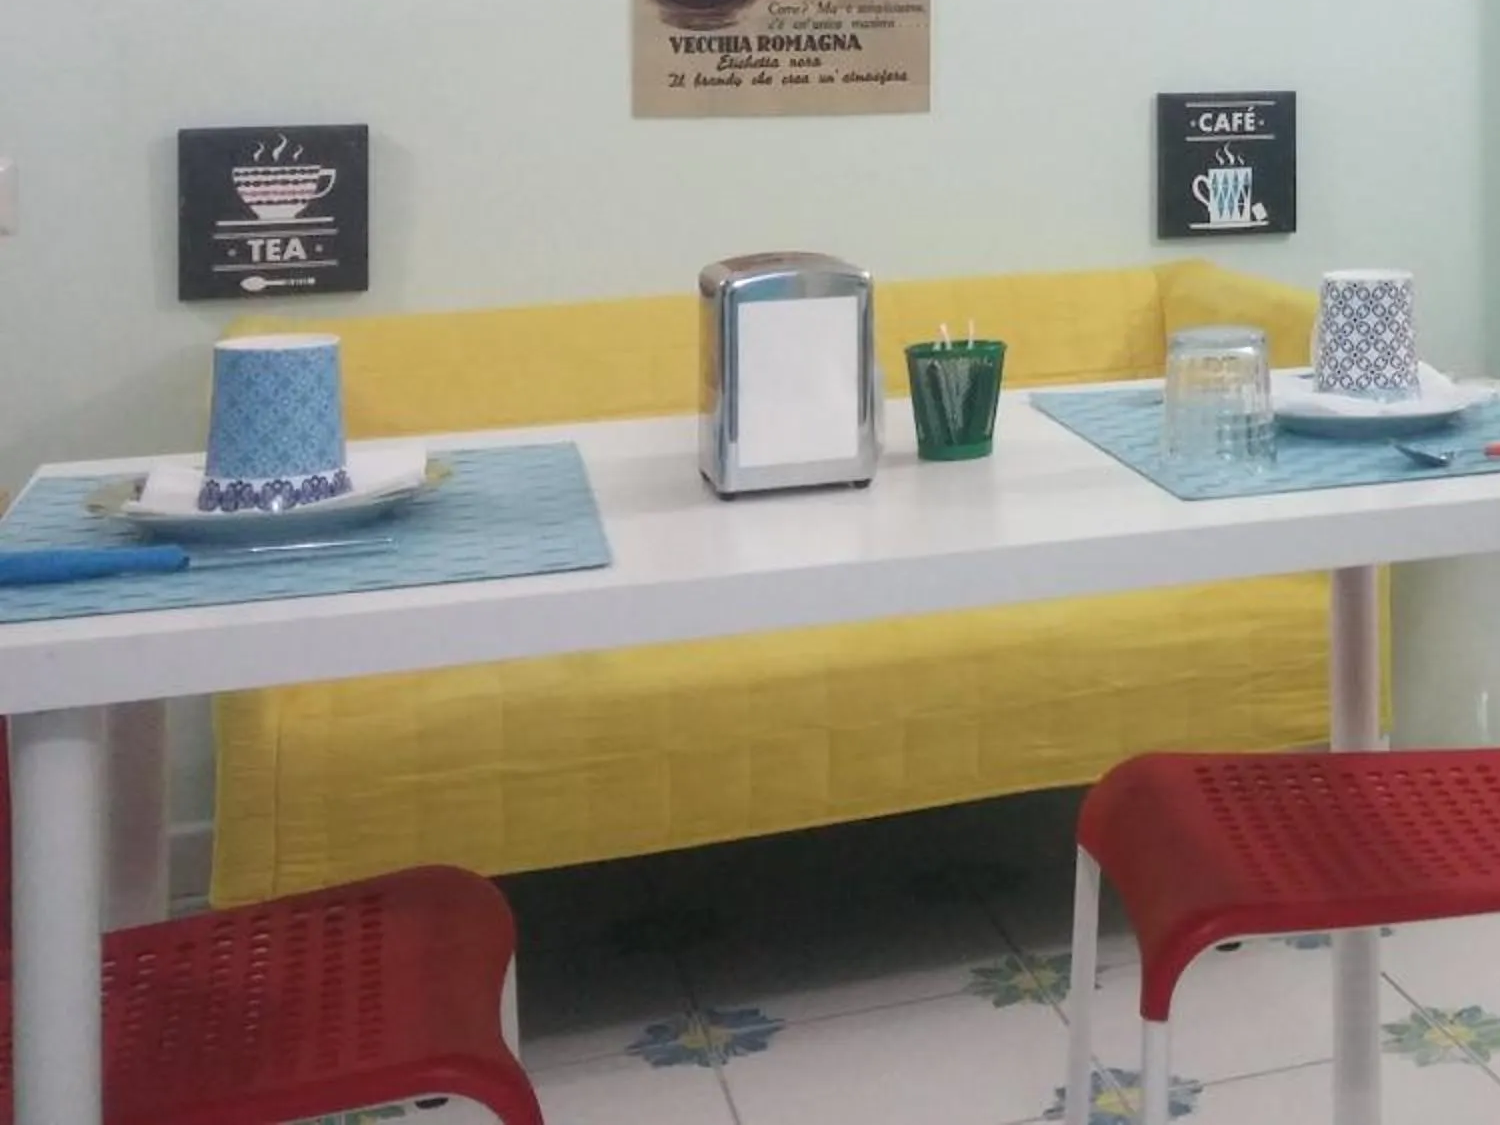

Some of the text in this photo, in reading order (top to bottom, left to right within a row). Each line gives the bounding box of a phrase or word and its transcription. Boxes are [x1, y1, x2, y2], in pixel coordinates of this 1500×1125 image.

[669, 33, 862, 53] VECCHIA ROMAGNA
[751, 71, 773, 85] che
[1199, 106, 1256, 132] CAFÉ
[247, 237, 307, 263] TEA
